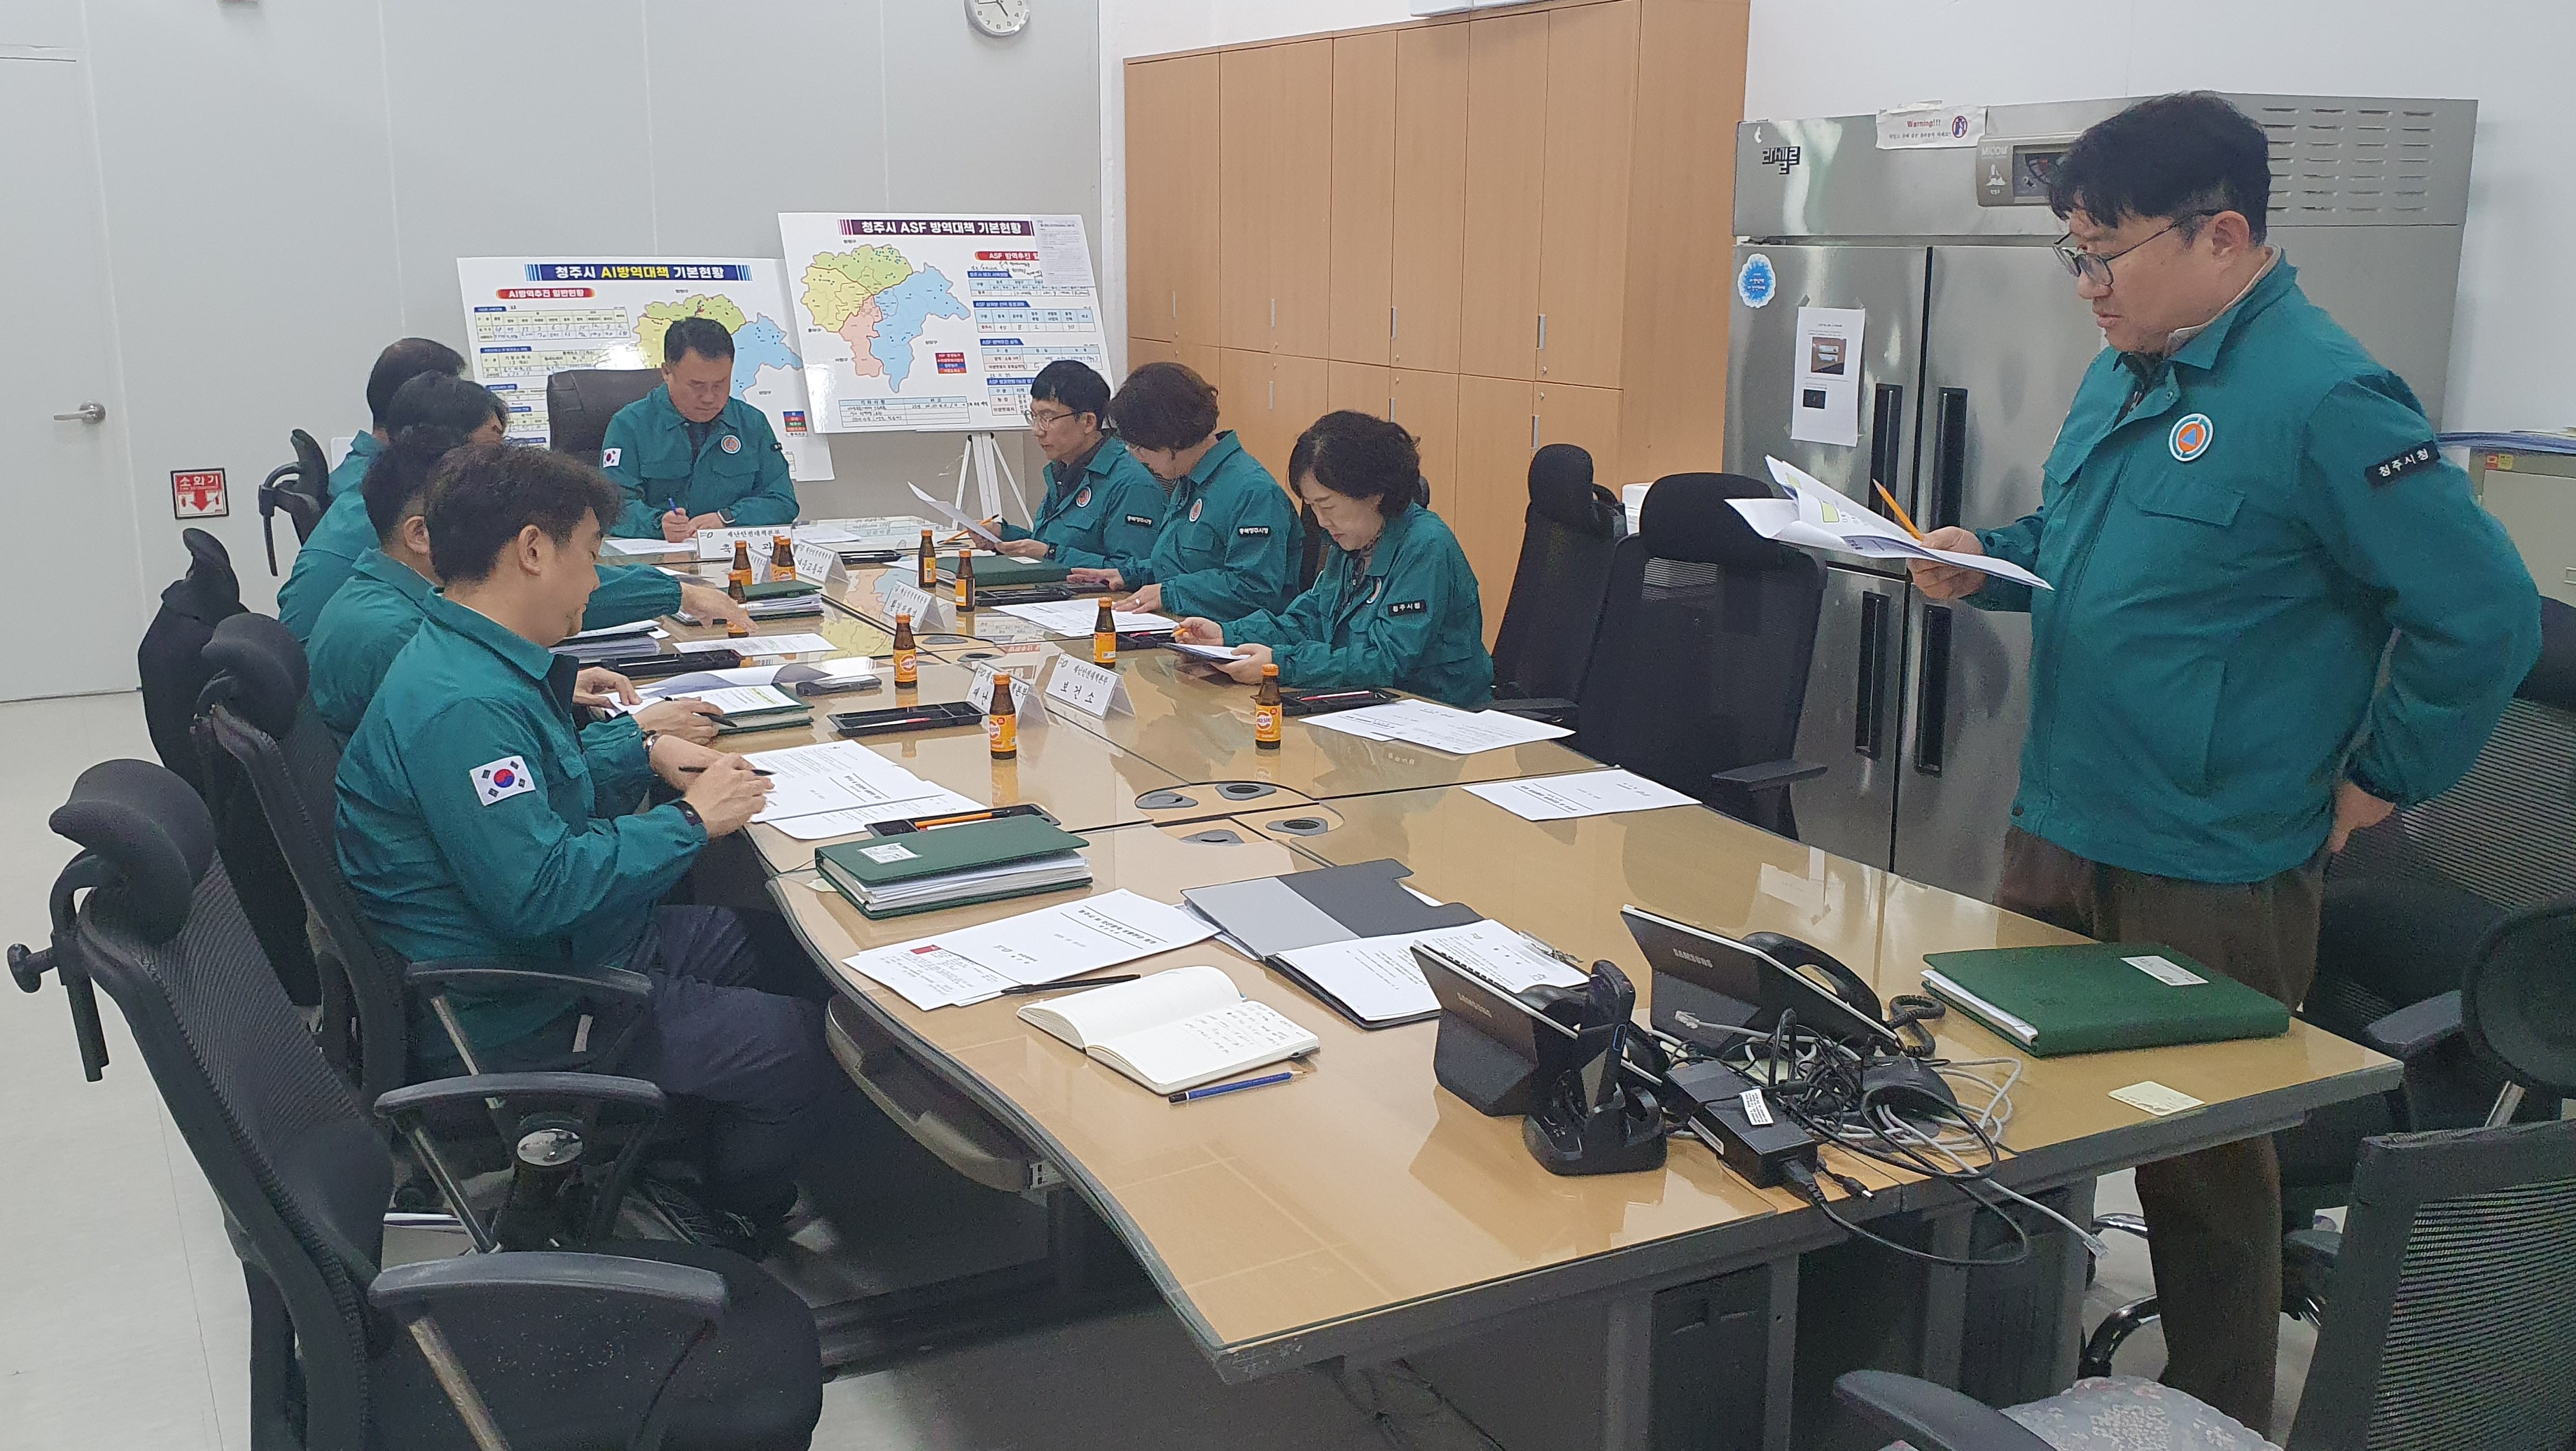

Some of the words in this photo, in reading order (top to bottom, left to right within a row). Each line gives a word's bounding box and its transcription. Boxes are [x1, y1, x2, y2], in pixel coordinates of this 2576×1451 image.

[1907, 118, 1941, 128] Warning!!!
[861, 221, 896, 233] 청주시
[900, 222, 926, 233] ASF
[930, 222, 975, 234] 방역대책
[978, 222, 1022, 234] 기본현황
[555, 265, 596, 279] 청주시
[600, 265, 670, 279] AI방역대책
[673, 265, 725, 279] 기본현황
[508, 289, 551, 298] AI방역추진
[552, 289, 585, 298] 일반현황
[2378, 447, 2429, 477] 청주시청
[719, 542, 773, 554] 축과
[1060, 681, 1095, 704] 보건소
[1672, 947, 1713, 969] SAMSUNG
[1456, 992, 1493, 1018] SAMSUNG
